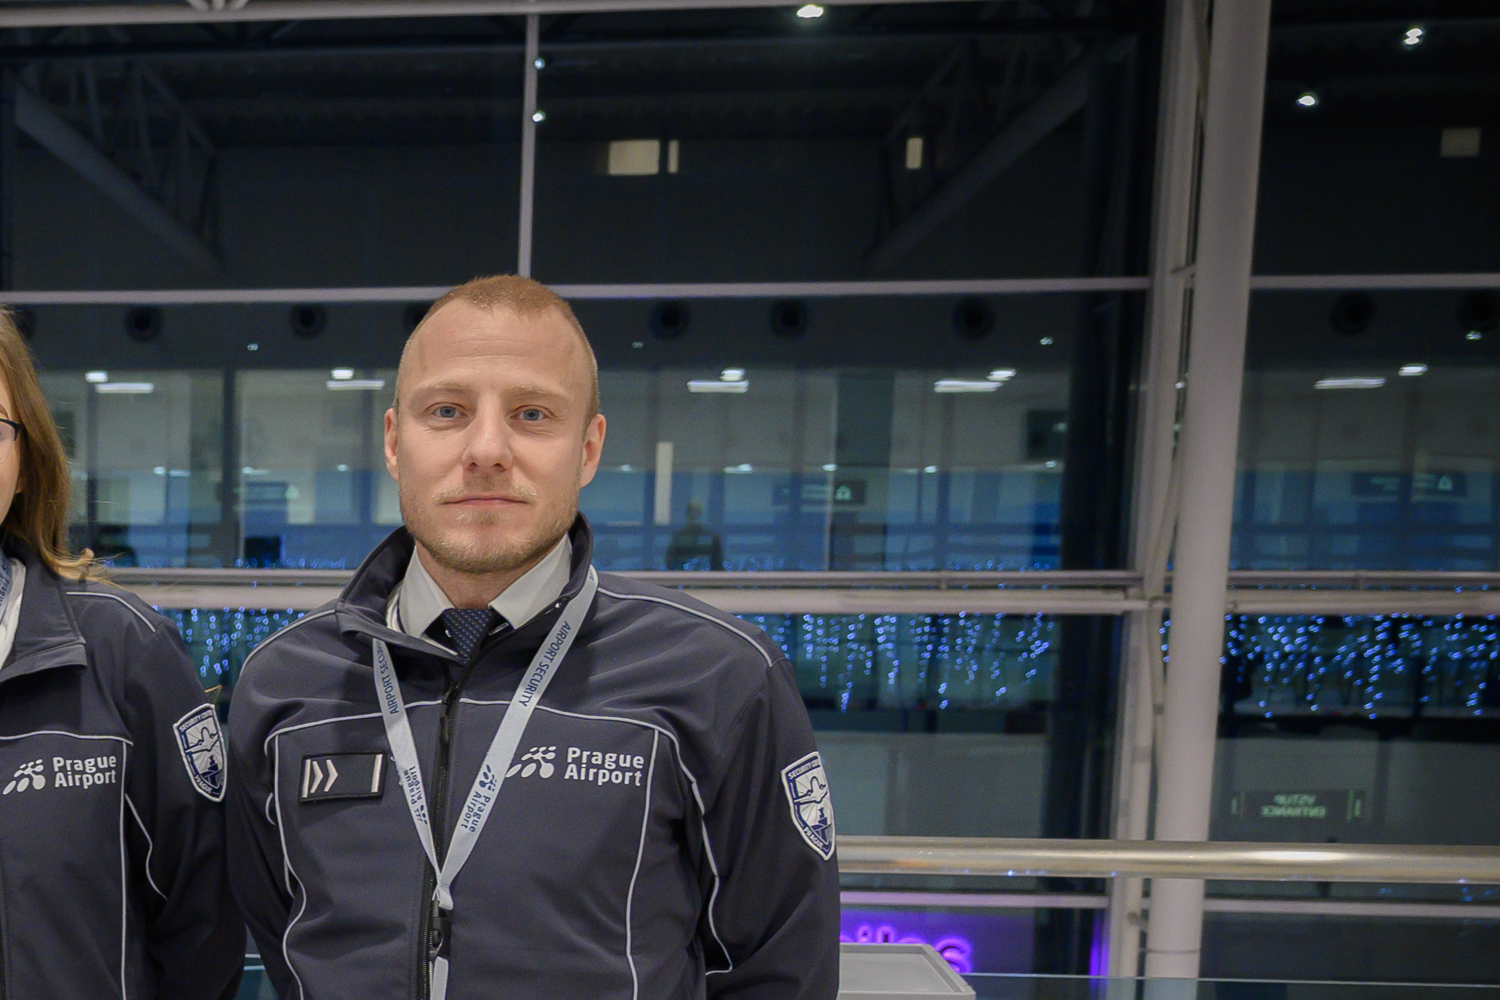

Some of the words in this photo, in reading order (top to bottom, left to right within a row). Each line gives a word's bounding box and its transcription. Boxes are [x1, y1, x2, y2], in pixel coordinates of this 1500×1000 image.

[543, 620, 572, 664] AIRPORT
[381, 674, 400, 715] AIRPORT
[518, 661, 550, 708] SECURITY
[52, 755, 118, 774] Prague
[563, 763, 642, 787] Airport
[566, 747, 645, 770] Prague
[54, 769, 118, 790] Airport
[403, 769, 418, 805] Prague
[408, 765, 423, 801] Airport
[460, 790, 483, 829] Airport
[468, 795, 492, 833] Prague
[802, 826, 825, 850] PRAGUE
